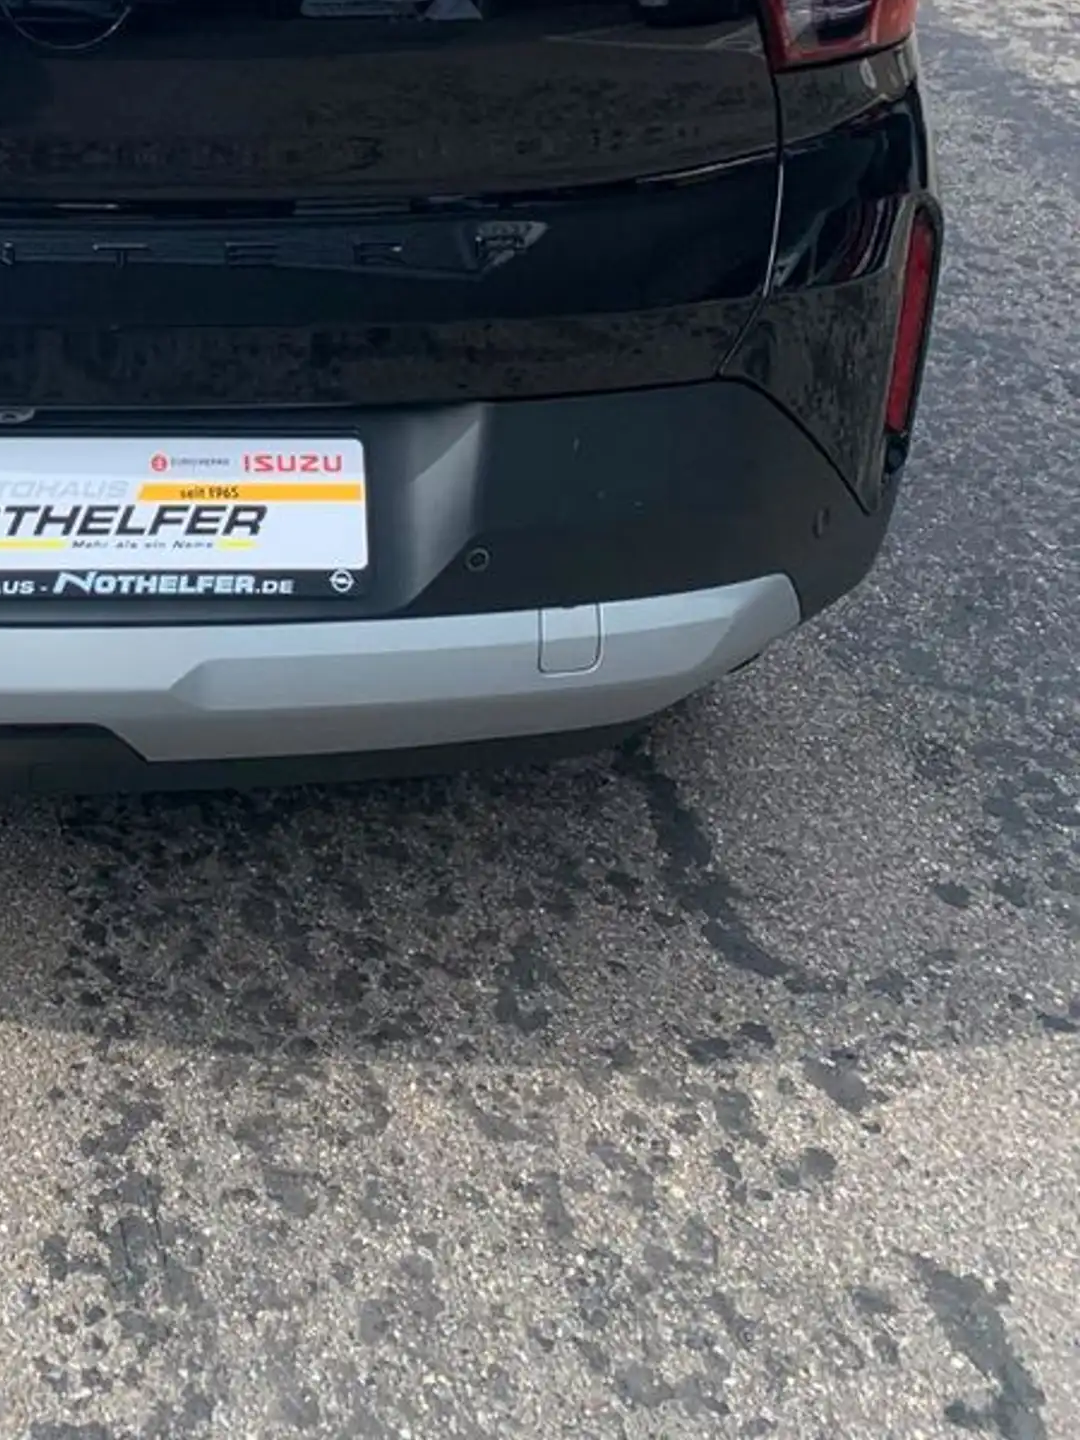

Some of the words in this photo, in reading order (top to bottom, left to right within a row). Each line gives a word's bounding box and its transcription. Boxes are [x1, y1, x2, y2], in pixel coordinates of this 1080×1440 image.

[243, 455, 343, 472] ISUZU
[180, 486, 206, 499] seit
[207, 486, 240, 499] 1965
